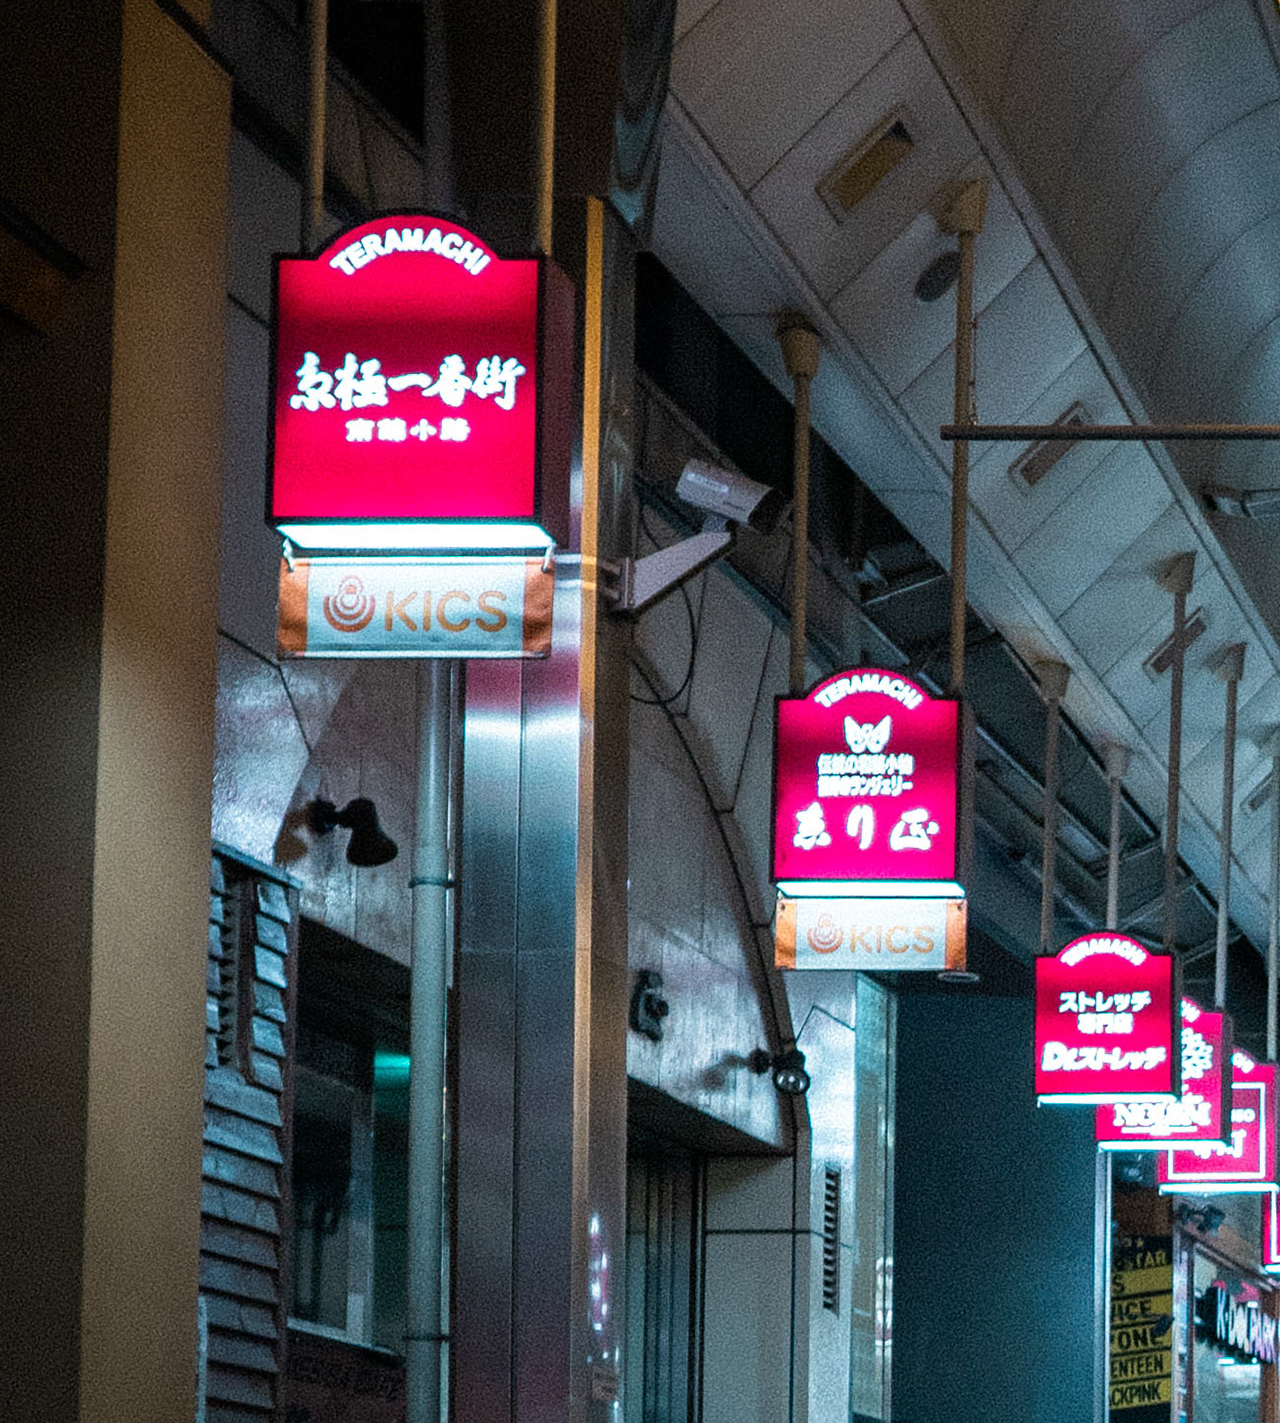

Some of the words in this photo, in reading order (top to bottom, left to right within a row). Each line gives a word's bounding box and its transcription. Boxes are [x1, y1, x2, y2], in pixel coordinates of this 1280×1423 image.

[329, 228, 491, 275] TERAMACHI
[289, 351, 526, 411] 京極一番街
[384, 590, 508, 633] KICS
[813, 673, 923, 710] TERAMACHI
[849, 925, 935, 954] KICS
[1059, 991, 1151, 1012] ストレッチ
[1111, 1299, 1151, 1322] ICE
[1111, 1381, 1161, 1406] CKPINK
